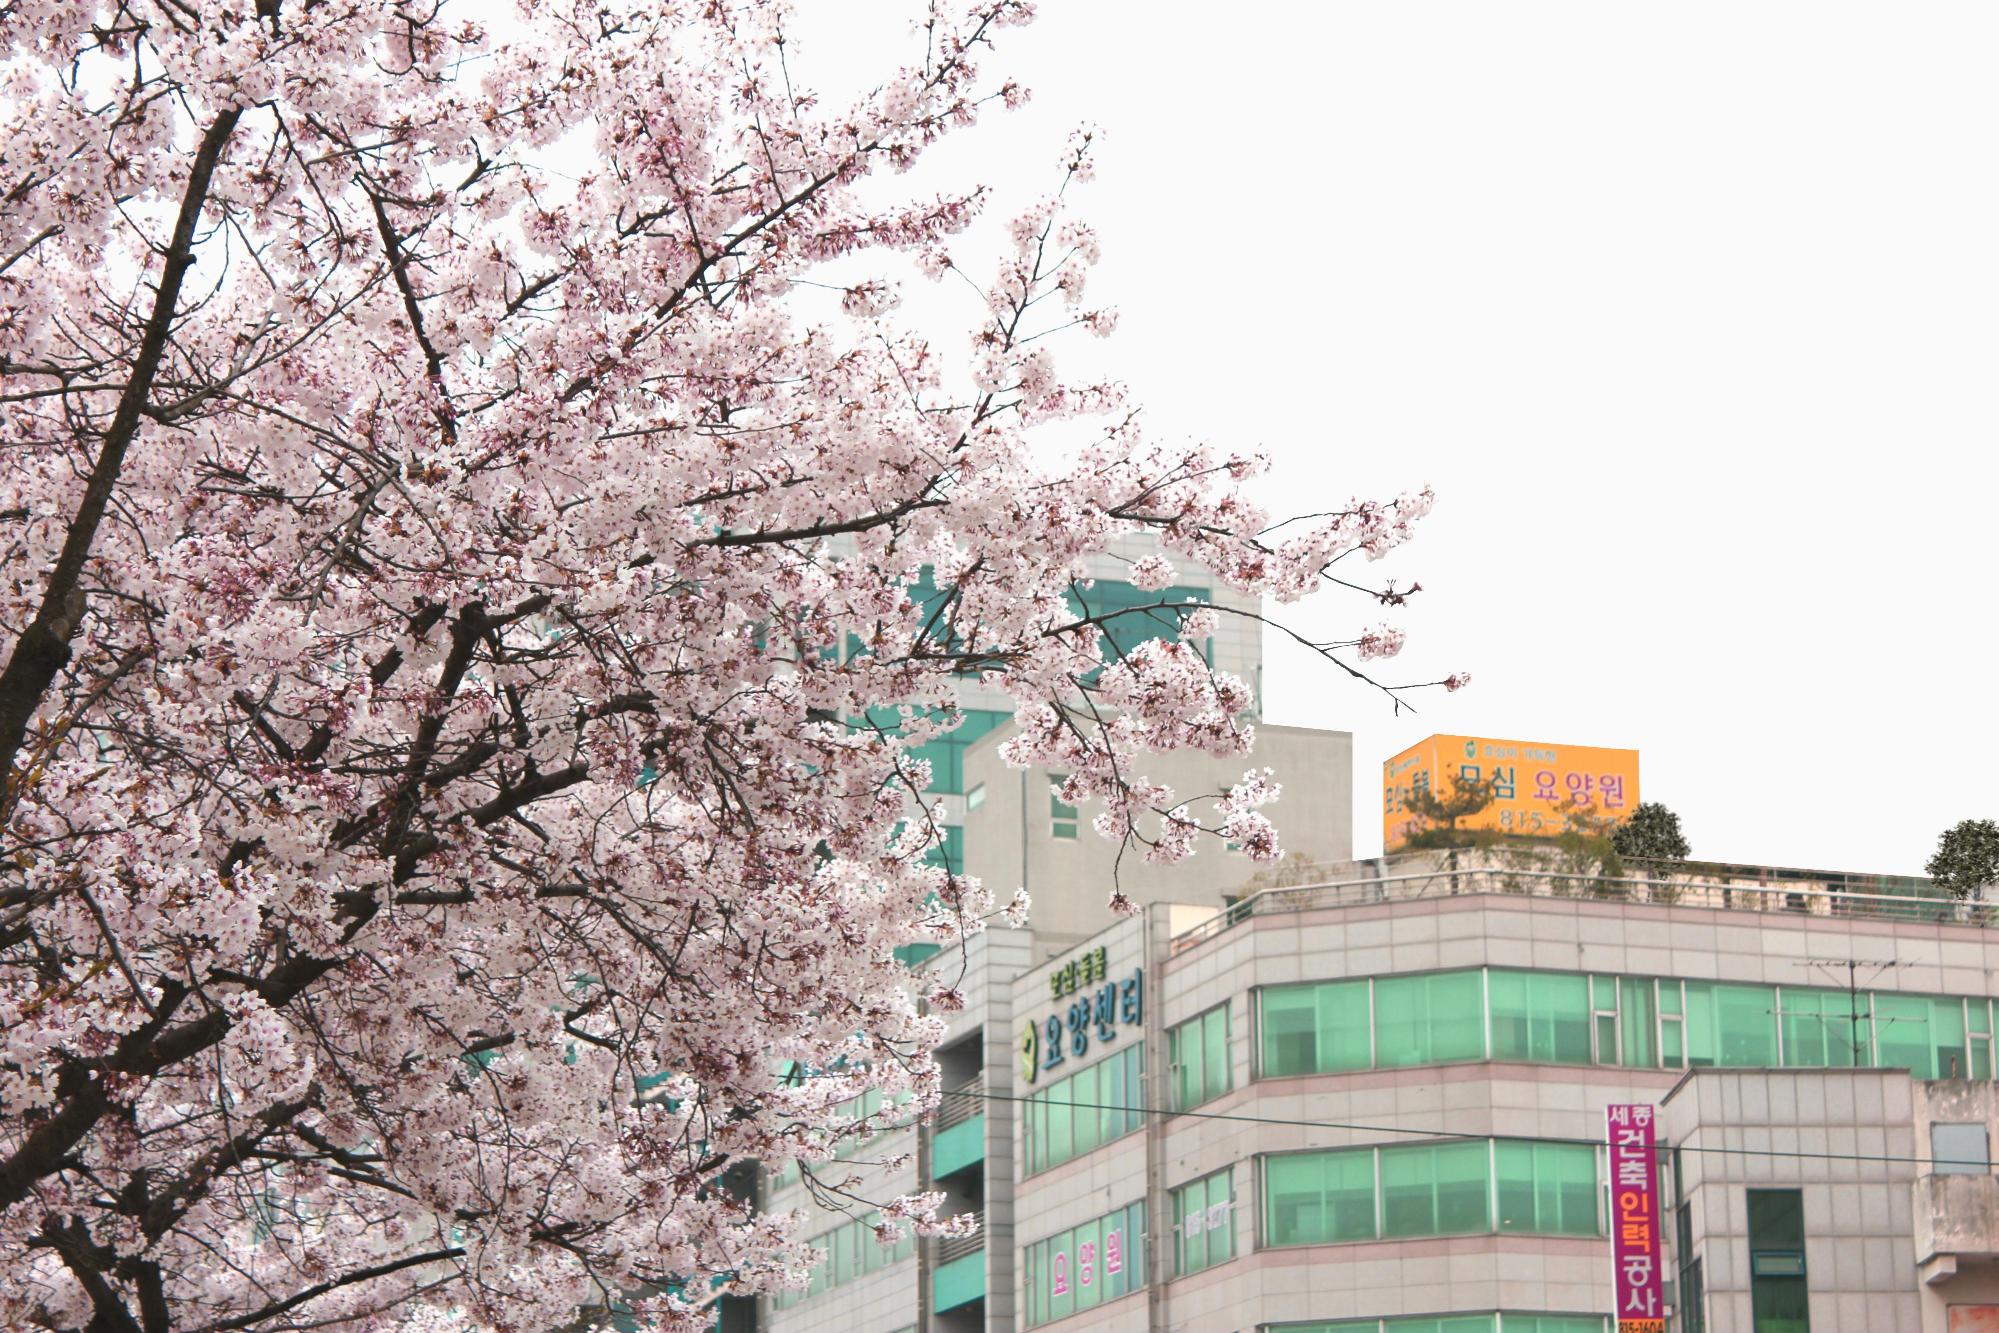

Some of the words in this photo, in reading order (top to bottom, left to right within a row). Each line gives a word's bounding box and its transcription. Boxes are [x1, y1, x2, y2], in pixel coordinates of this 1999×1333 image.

[1533, 769, 1624, 808] 요양원
[1041, 967, 1143, 1070] 요양센터
[1610, 1106, 1652, 1126] 세종
[1053, 1230, 1122, 1296] 요양원
